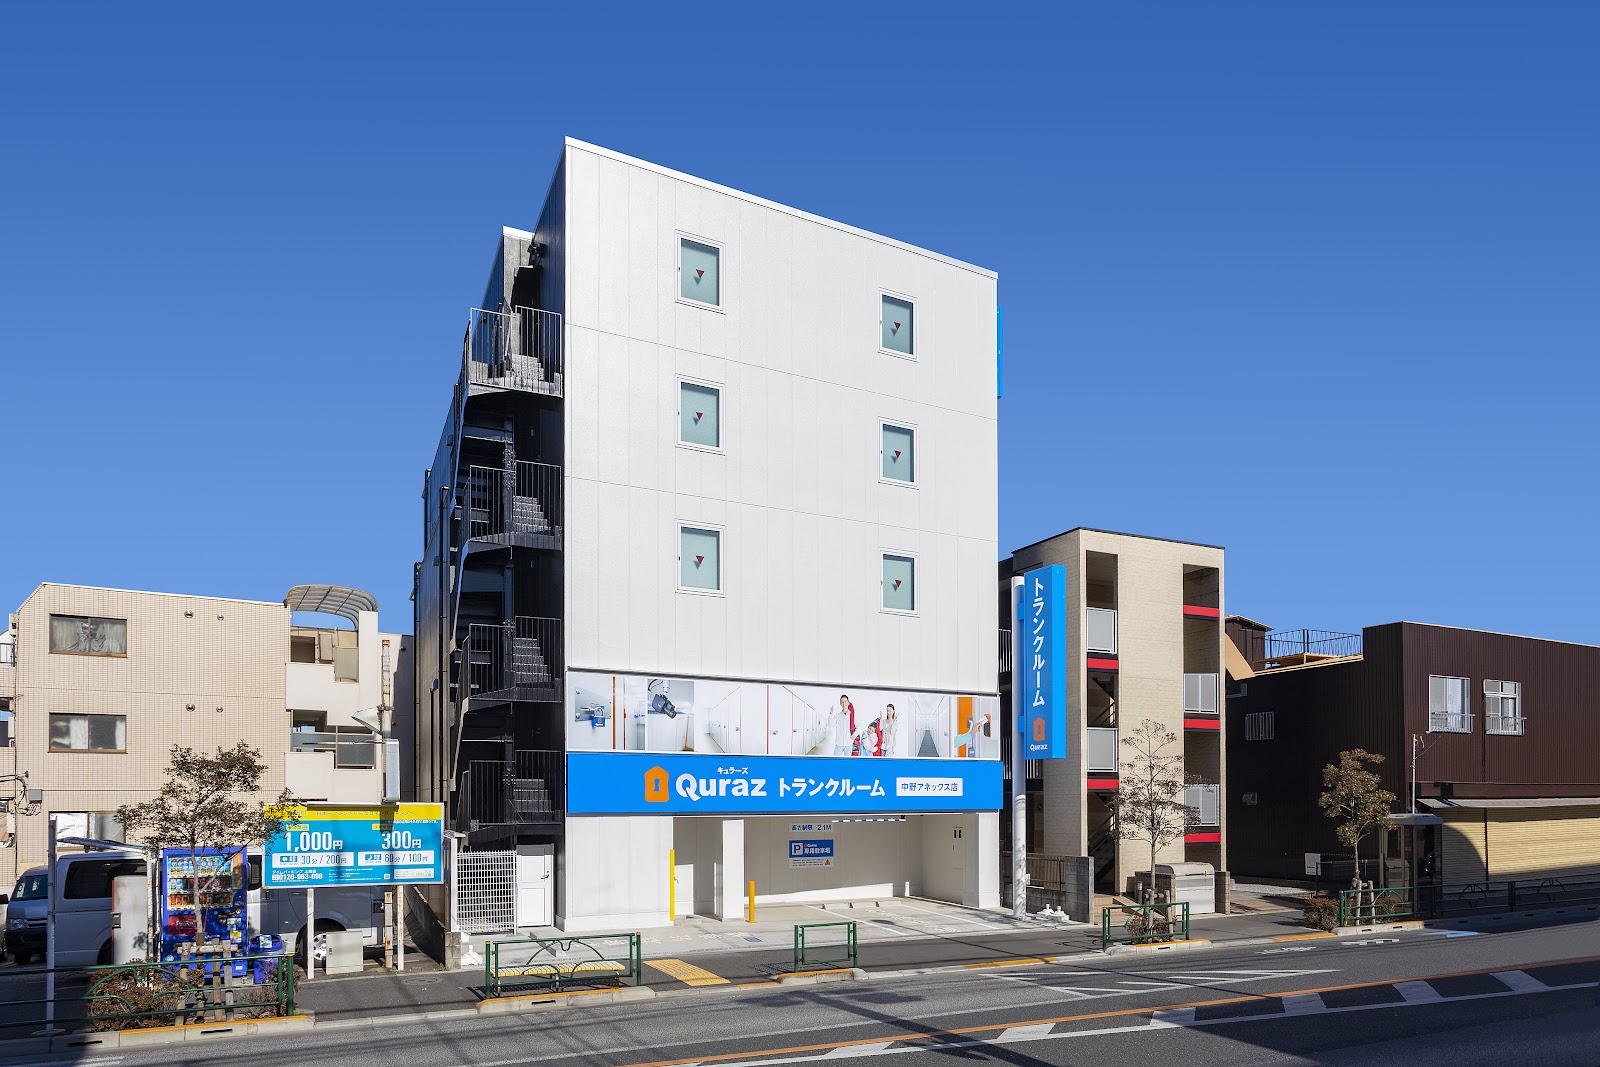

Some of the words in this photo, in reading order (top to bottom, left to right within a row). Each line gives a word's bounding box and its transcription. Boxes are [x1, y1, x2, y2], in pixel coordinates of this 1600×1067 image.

[1032, 577, 1046, 708] トランクルーム
[1029, 743, 1048, 751] Quraz
[717, 766, 749, 775] キュラーズ
[675, 773, 767, 801] Quraz
[778, 777, 886, 798] トランクルーム
[901, 782, 959, 793] 中野アネックス店
[285, 831, 343, 853] 1,000円
[381, 830, 422, 850] 300円
[793, 844, 801, 854] P
[326, 854, 347, 865] 200円
[409, 853, 428, 863] 100円
